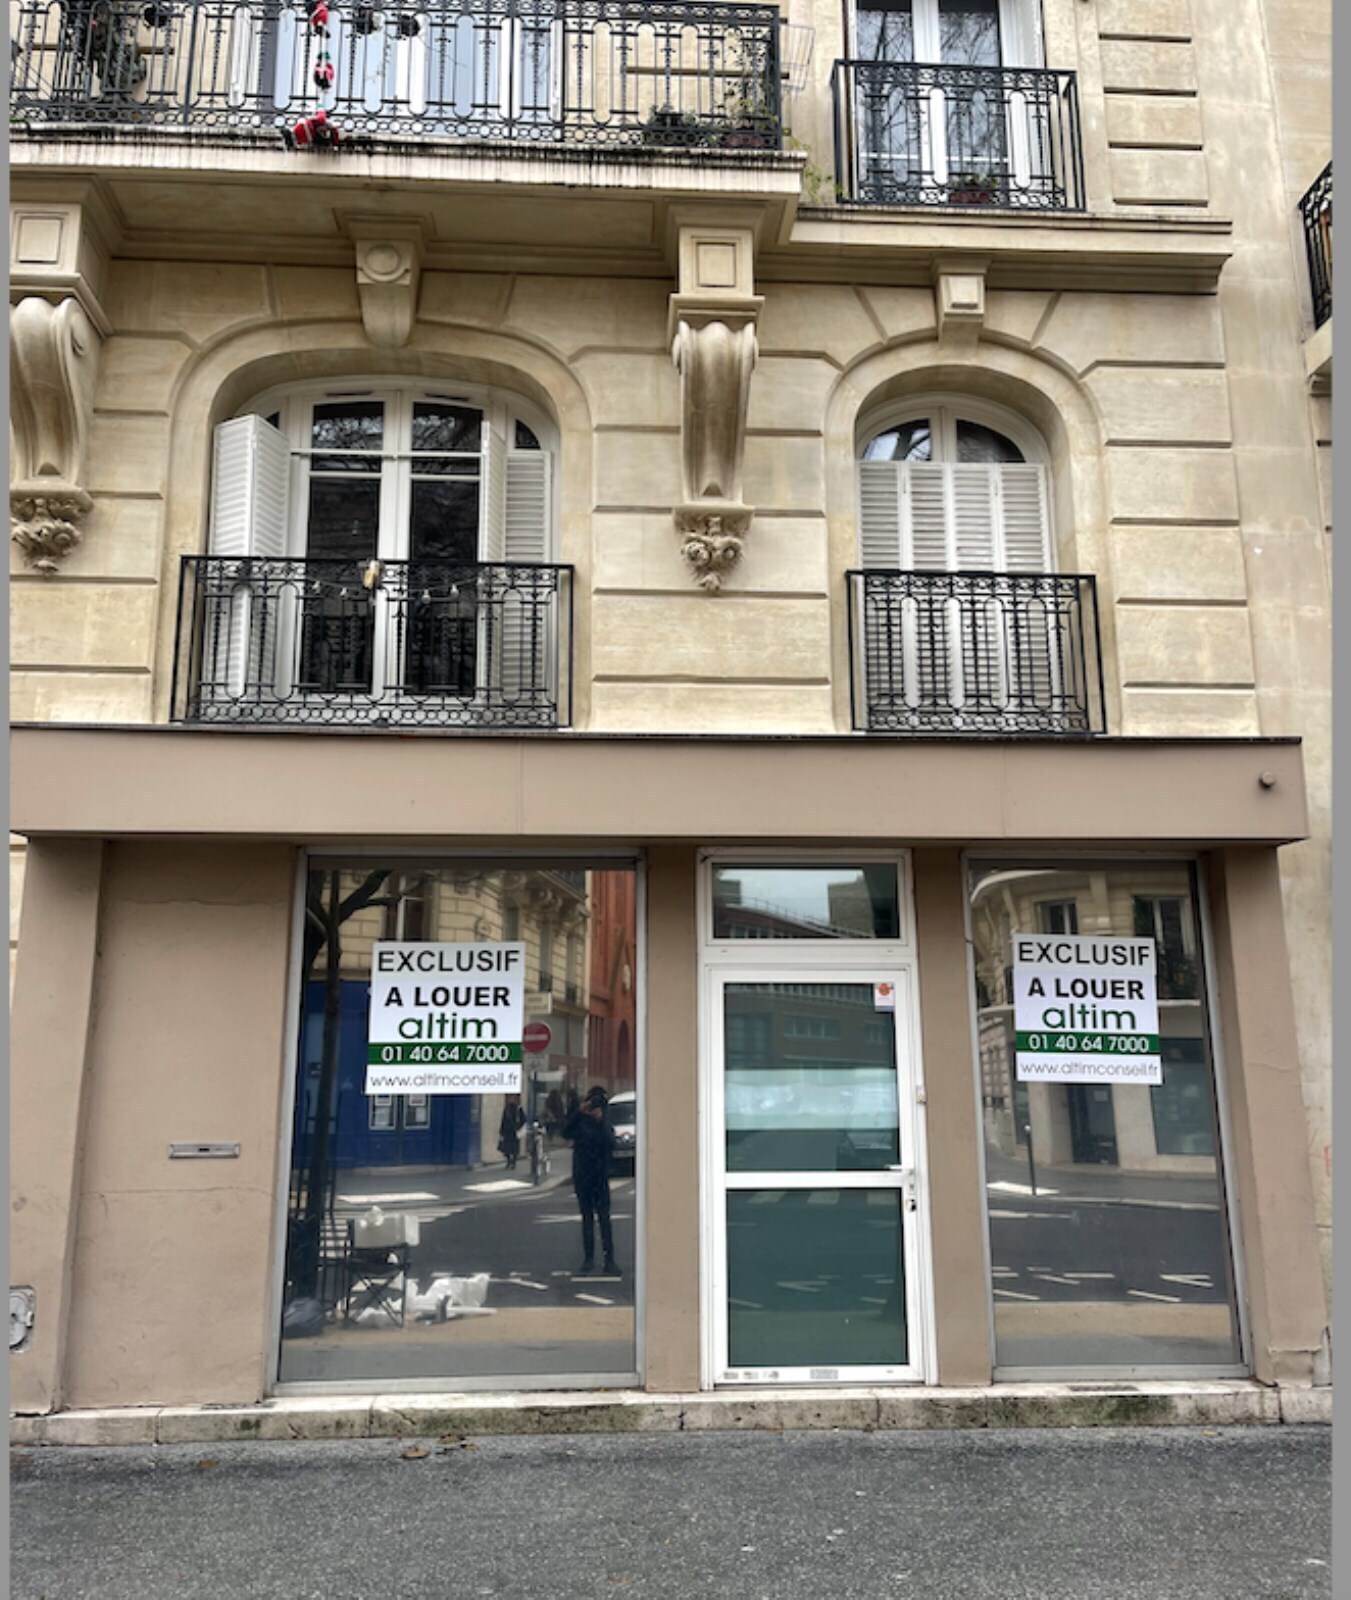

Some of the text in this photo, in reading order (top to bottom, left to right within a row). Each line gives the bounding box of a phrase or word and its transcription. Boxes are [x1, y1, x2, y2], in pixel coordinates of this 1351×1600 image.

[378, 950, 520, 972] EXCLUSIF
[1018, 942, 1150, 966] EXCLUSIF
[384, 986, 404, 1007] A
[414, 986, 511, 1007] LOUER
[1028, 977, 1145, 1000] A LOUER
[398, 1012, 498, 1039] altim
[1042, 1003, 1136, 1030] altim
[381, 1046, 509, 1062] 01 40 64 7000
[1028, 1035, 1150, 1053] 01 40 64 7000
[1020, 1061, 1158, 1077] www.altimconseil.fr
[370, 1072, 518, 1088] www.altimconseil.fr
